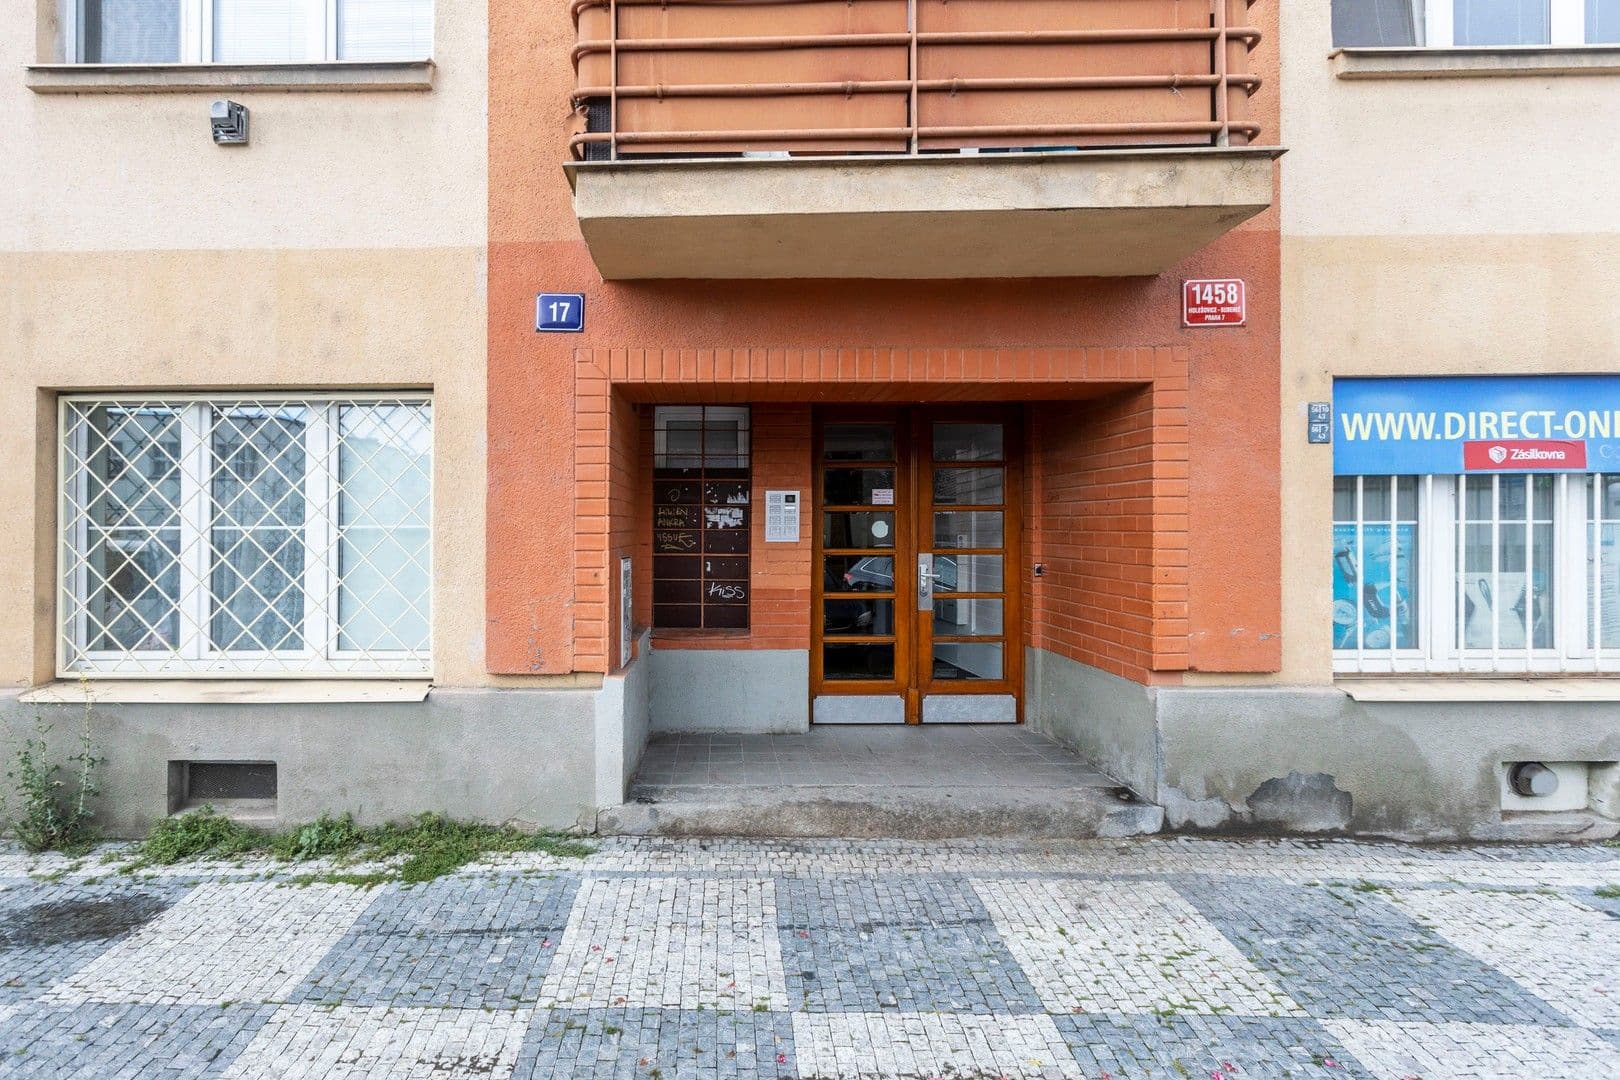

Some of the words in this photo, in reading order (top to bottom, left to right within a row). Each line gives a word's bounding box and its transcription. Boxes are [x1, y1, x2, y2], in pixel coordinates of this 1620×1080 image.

[1192, 283, 1238, 304] 1458
[549, 302, 571, 322] 17
[1510, 448, 1566, 460] Zásilkovna
